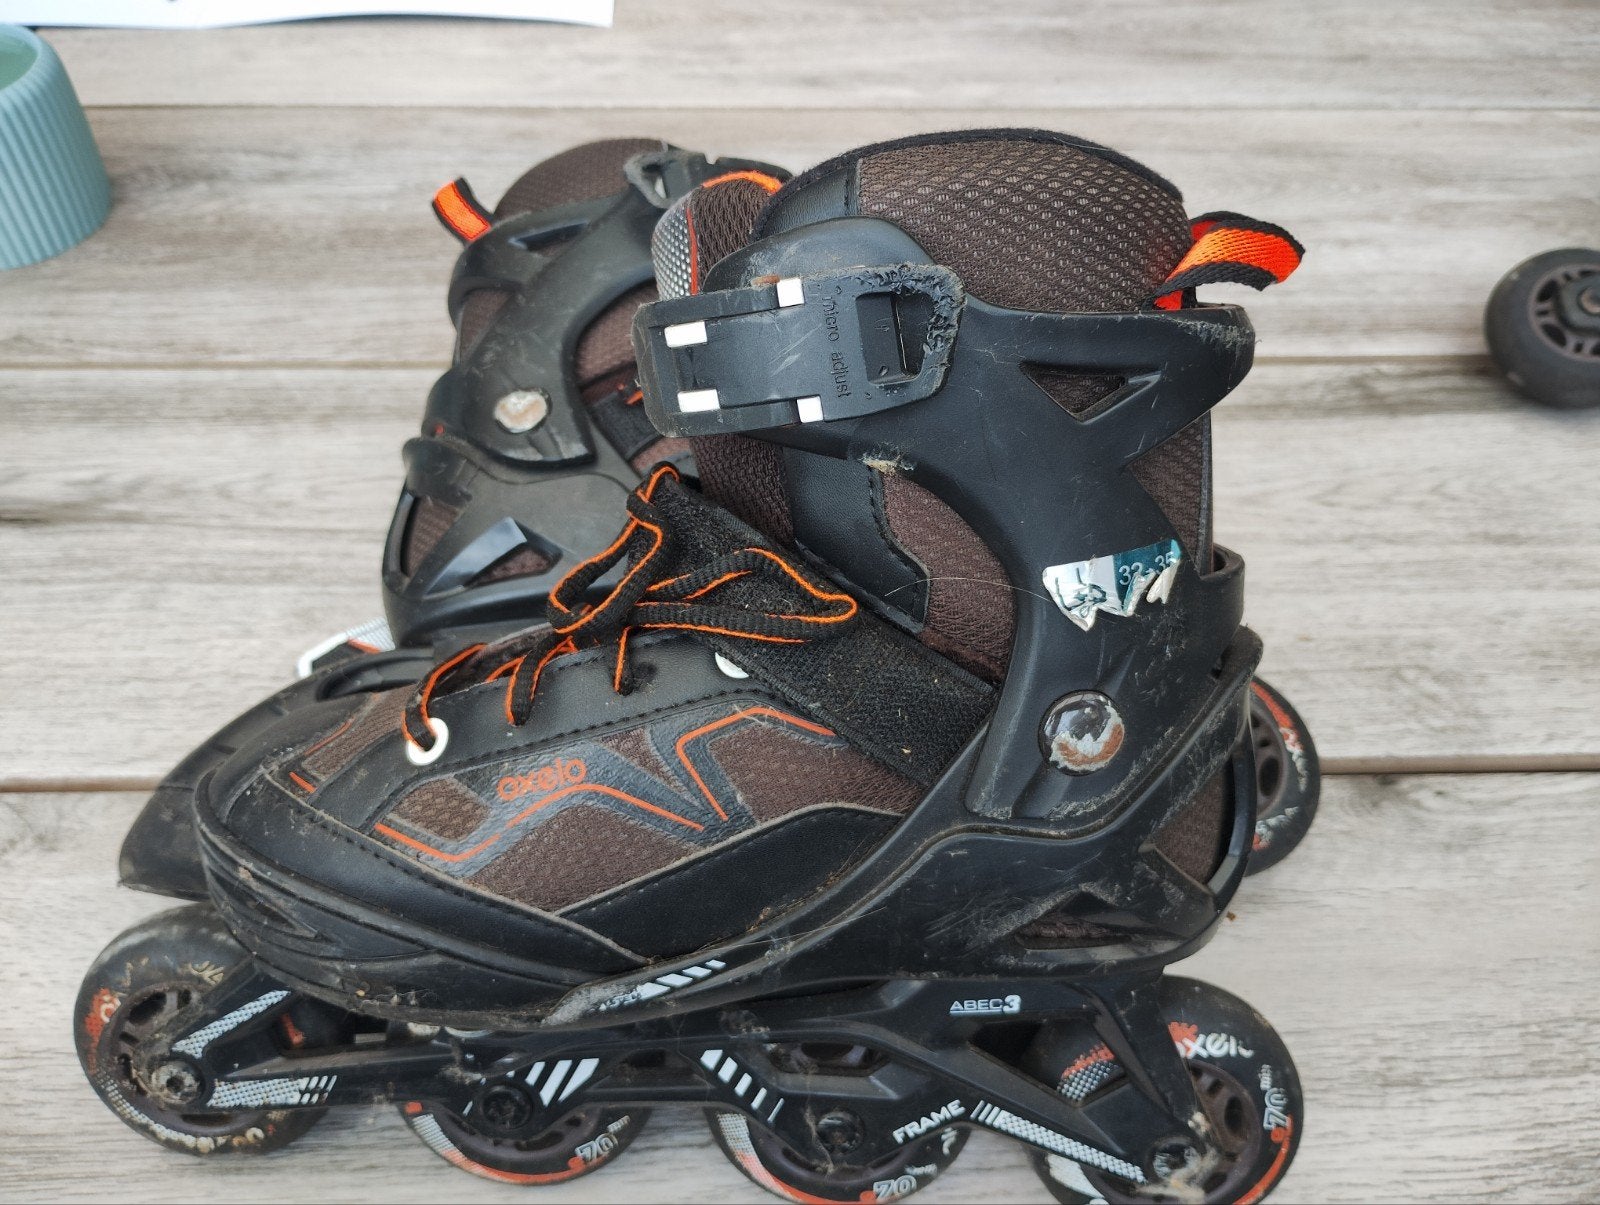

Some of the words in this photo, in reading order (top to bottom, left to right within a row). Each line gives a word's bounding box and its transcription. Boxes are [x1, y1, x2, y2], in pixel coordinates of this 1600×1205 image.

[822, 296, 840, 343] micro
[831, 352, 853, 399] adjust
[496, 757, 588, 802] oxelo
[892, 1099, 967, 1145] FRAME
[873, 1174, 918, 1201] 70
